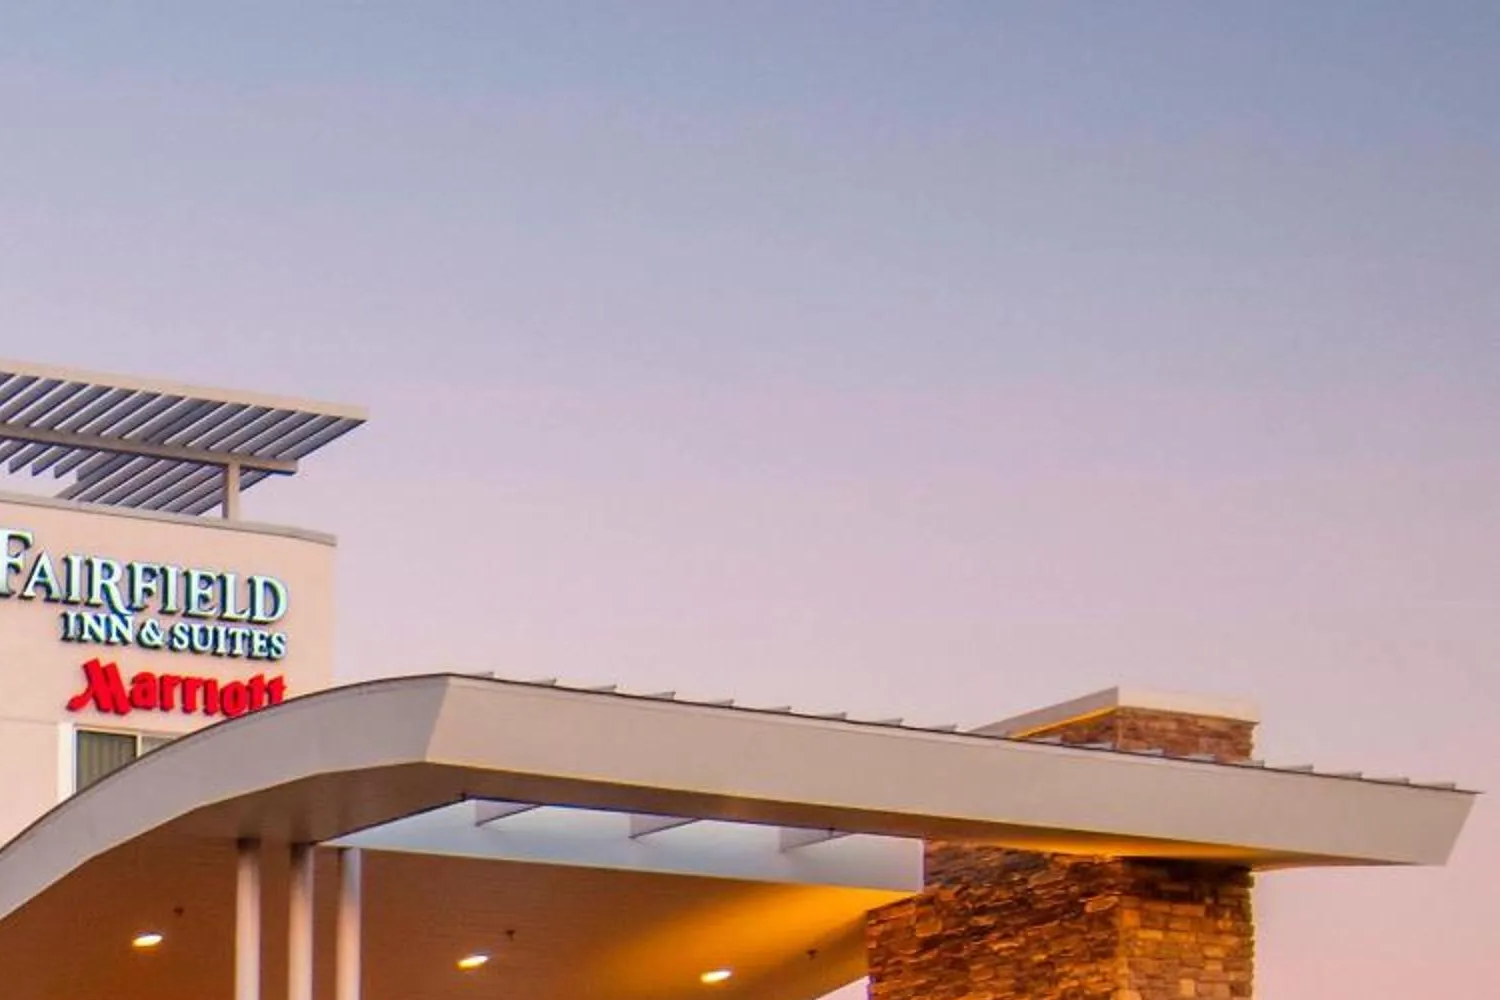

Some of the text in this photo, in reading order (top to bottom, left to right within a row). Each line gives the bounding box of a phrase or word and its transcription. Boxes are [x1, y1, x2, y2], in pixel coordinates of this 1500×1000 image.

[60, 611, 287, 660] INN & SUITES
[66, 658, 287, 719] Marriott
